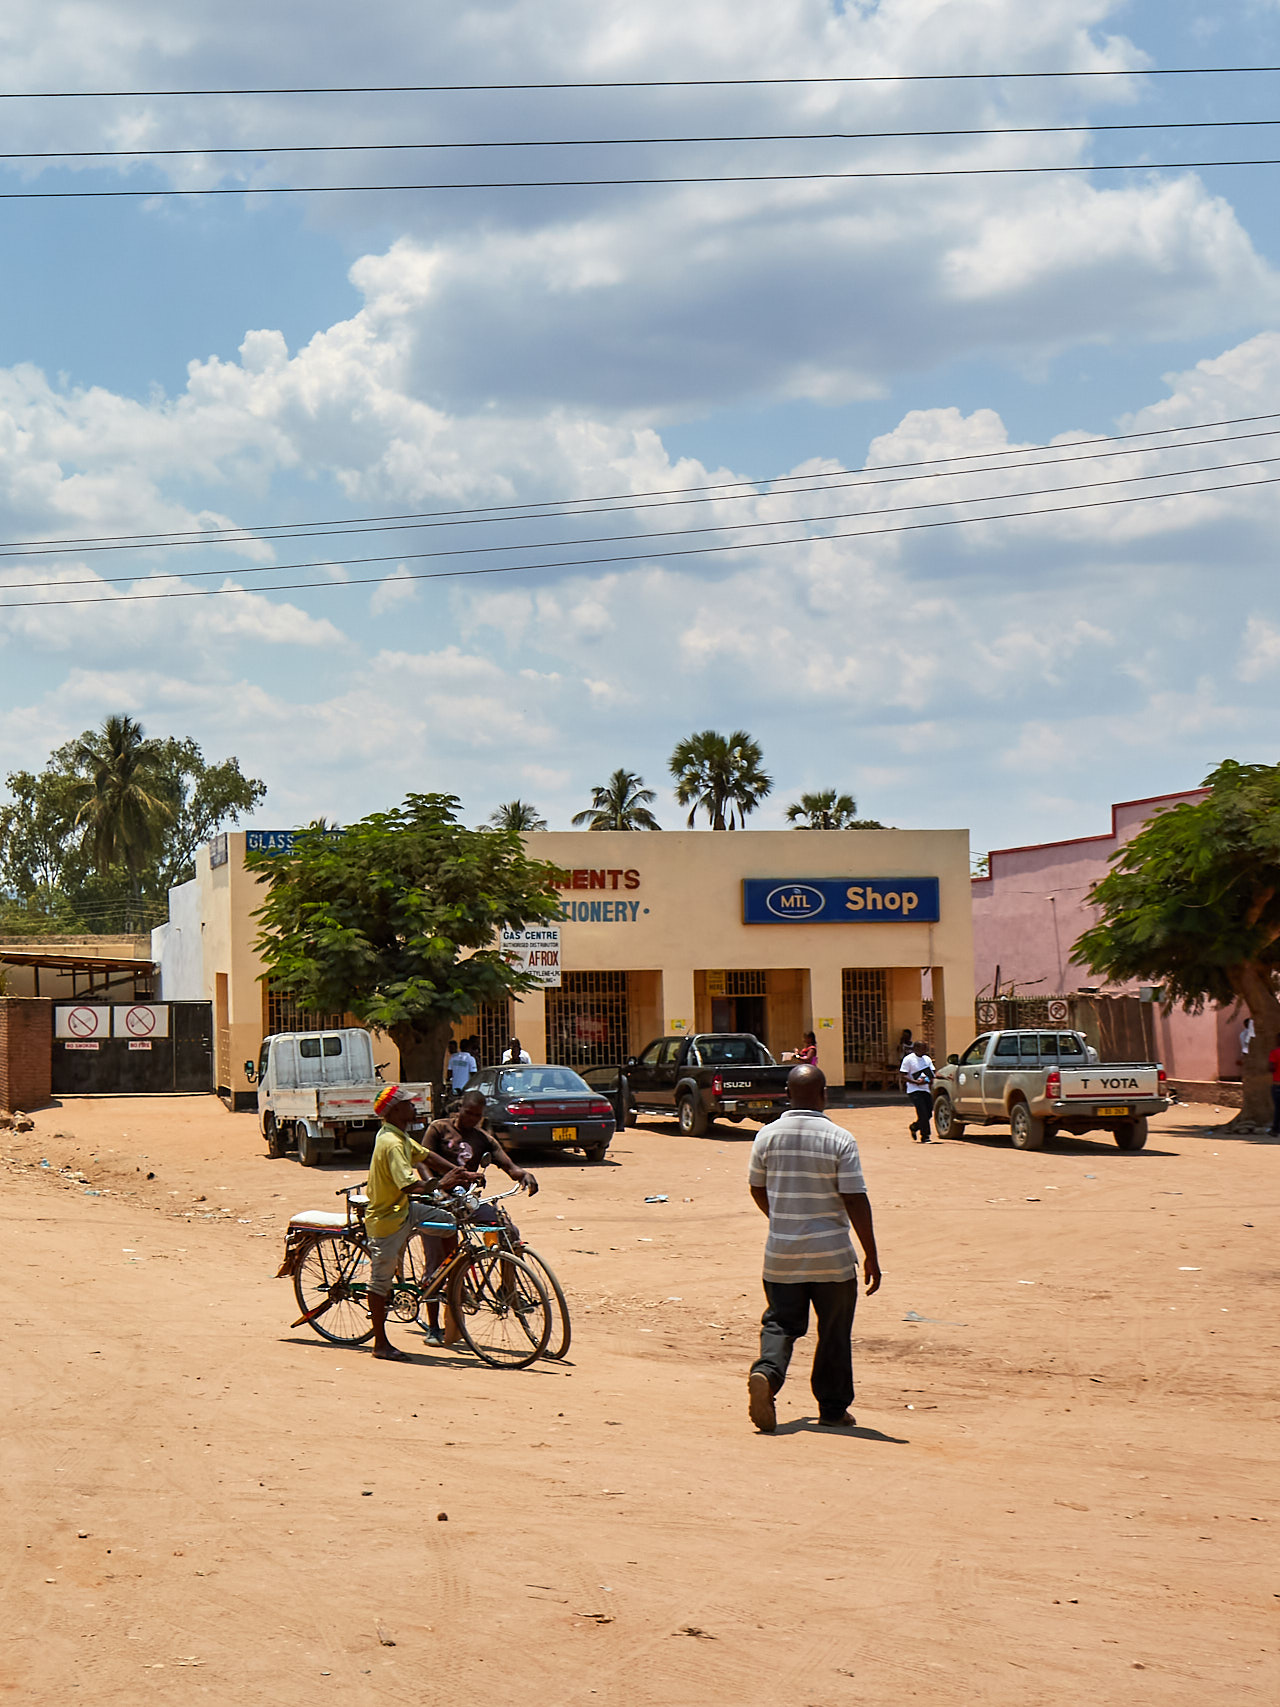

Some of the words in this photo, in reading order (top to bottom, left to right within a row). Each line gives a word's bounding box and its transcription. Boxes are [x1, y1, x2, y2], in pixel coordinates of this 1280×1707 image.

[248, 834, 295, 849] GLASS
[543, 869, 640, 890] MENTS
[780, 895, 811, 908] MTL
[845, 886, 918, 915] Shop
[552, 901, 640, 922] TIONERY
[503, 931, 521, 940] GAS
[525, 931, 558, 940] CENTRE
[528, 950, 559, 967] AFROX
[723, 1081, 752, 1089] ISUZU
